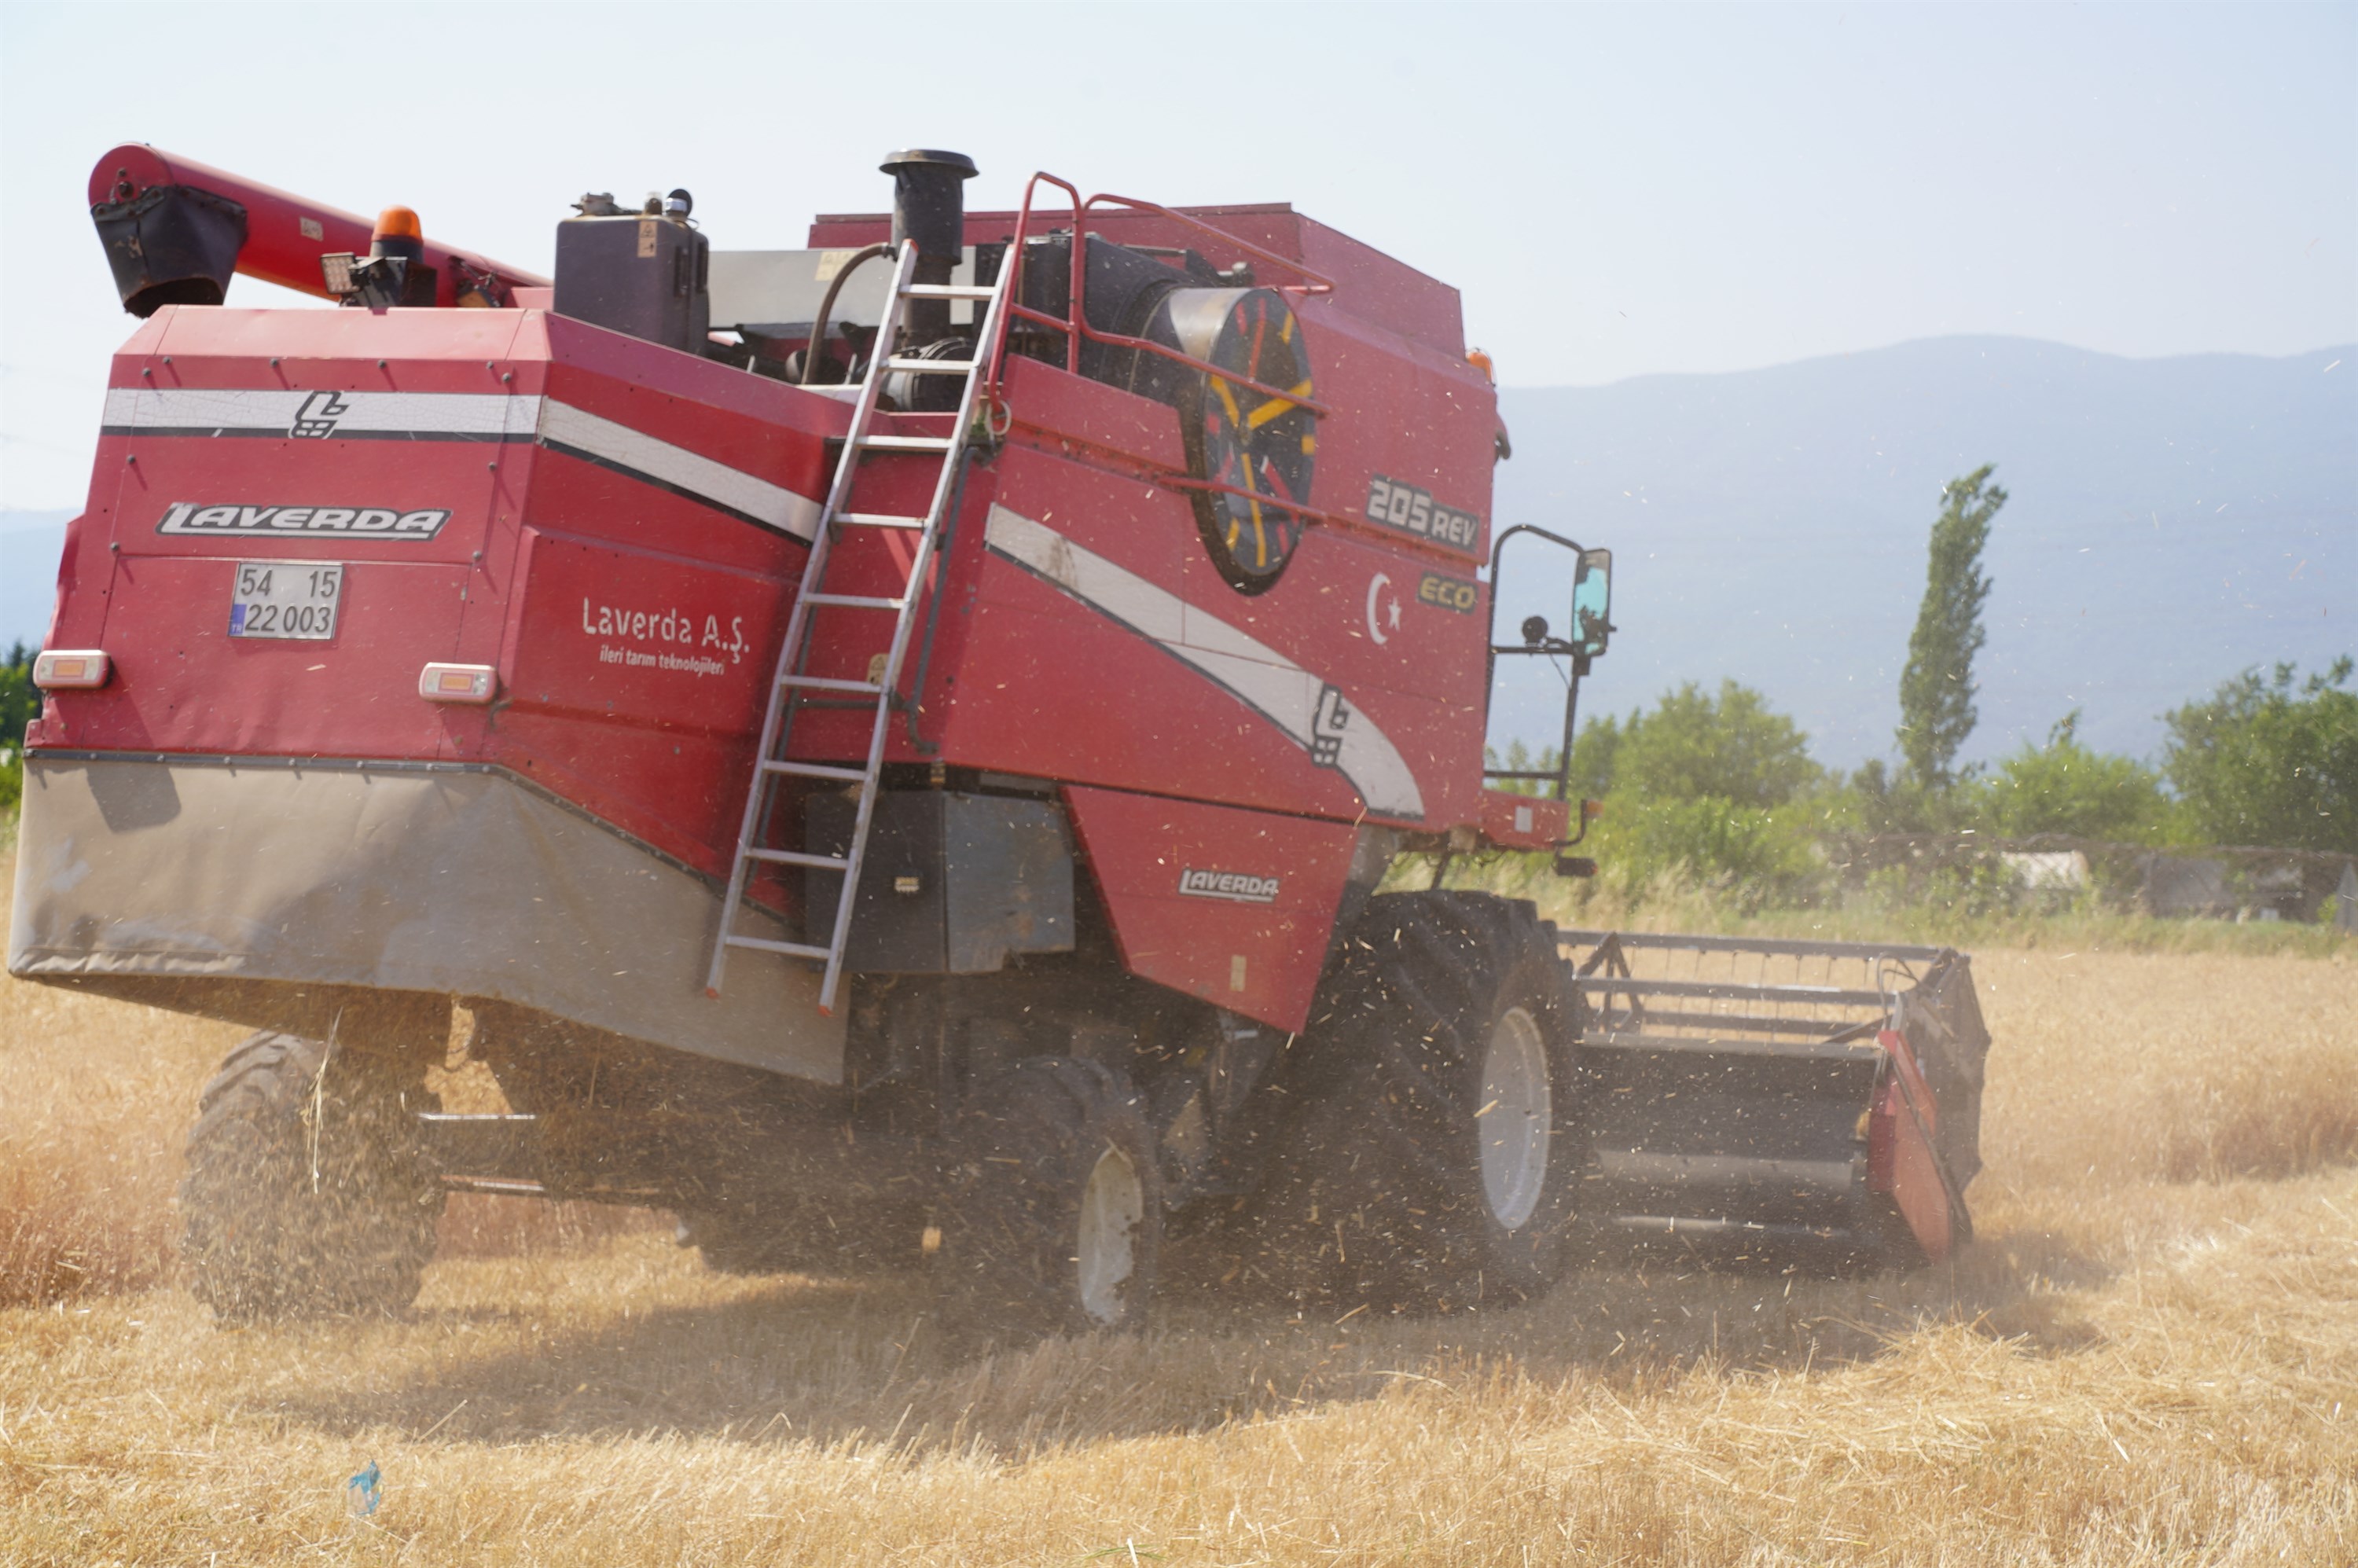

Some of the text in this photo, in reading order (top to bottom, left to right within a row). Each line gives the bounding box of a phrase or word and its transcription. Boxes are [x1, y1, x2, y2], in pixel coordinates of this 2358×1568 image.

[160, 502, 445, 539] LAVERDA
[1367, 479, 1477, 546] 205 REV
[241, 568, 337, 598] 54 15
[1420, 576, 1475, 609] ECO
[582, 597, 750, 665] Laverda A.Ş.
[600, 644, 624, 663] ileri
[626, 649, 656, 667] tarım
[1179, 868, 1280, 902] LAVERDA
